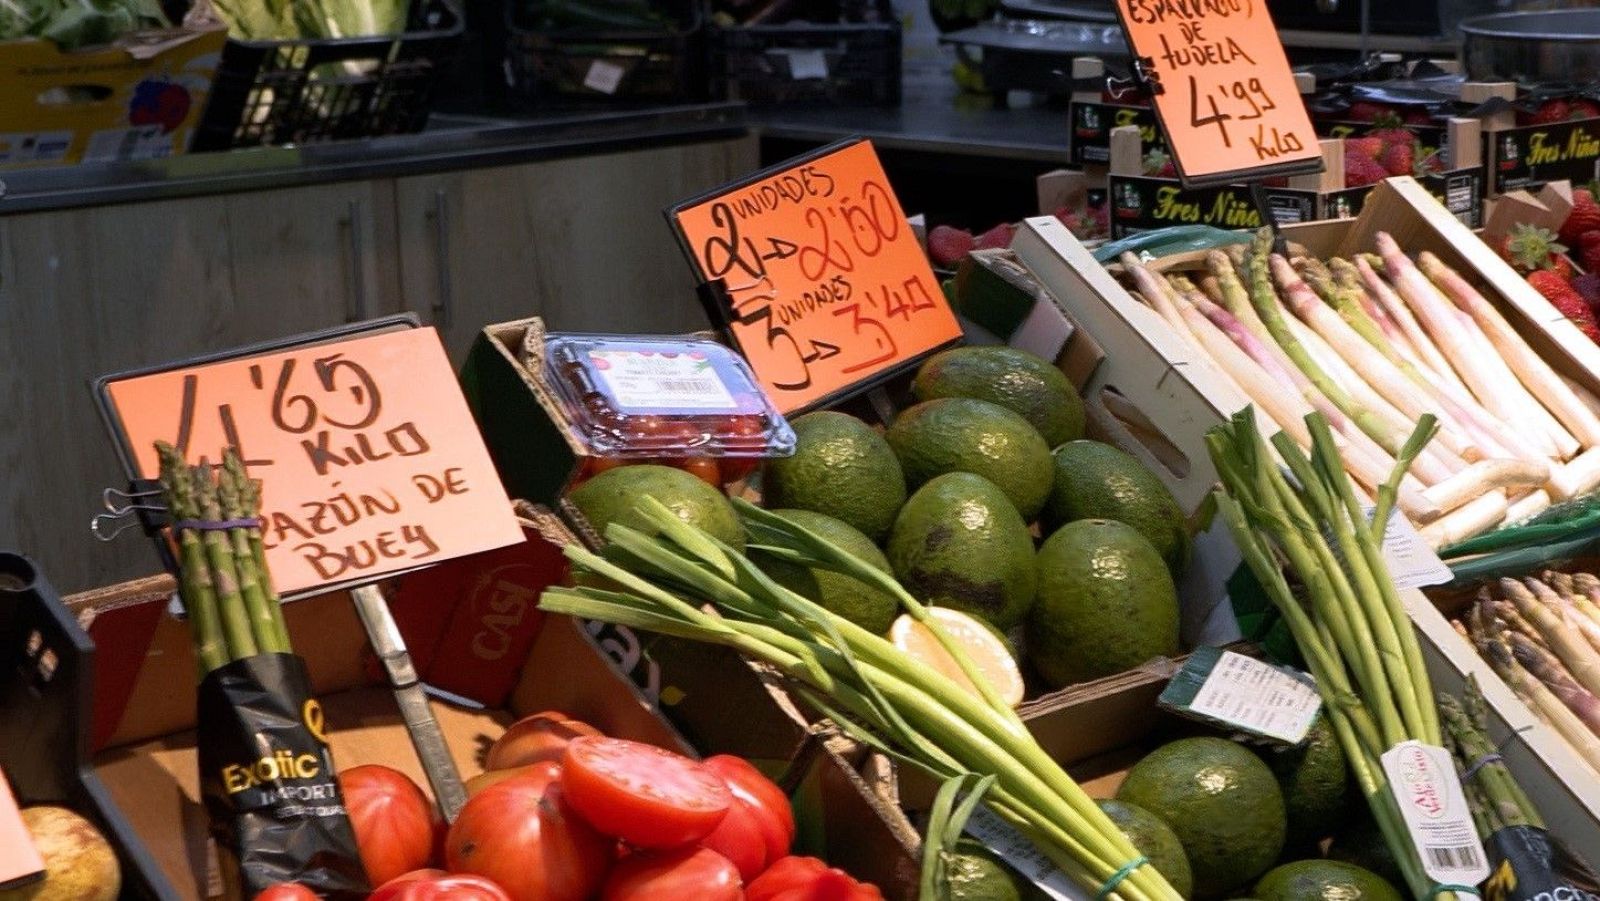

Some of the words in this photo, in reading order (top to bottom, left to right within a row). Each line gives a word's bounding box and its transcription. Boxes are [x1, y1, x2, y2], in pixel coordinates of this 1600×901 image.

[1179, 21, 1206, 45] DE
[1189, 75, 1276, 148] 4'99
[1249, 124, 1304, 160] KILO
[1525, 132, 1560, 166] Fres
[733, 166, 836, 219] UNIDADES
[1152, 186, 1200, 222] Fres
[705, 202, 766, 279] 2
[737, 304, 811, 391] 3
[777, 274, 853, 326] UNIDADES
[832, 275, 937, 374] 3'40
[301, 421, 431, 475] KILO
[412, 467, 471, 504] DE
[293, 524, 440, 581] BUEY
[222, 749, 319, 795] Exotic
